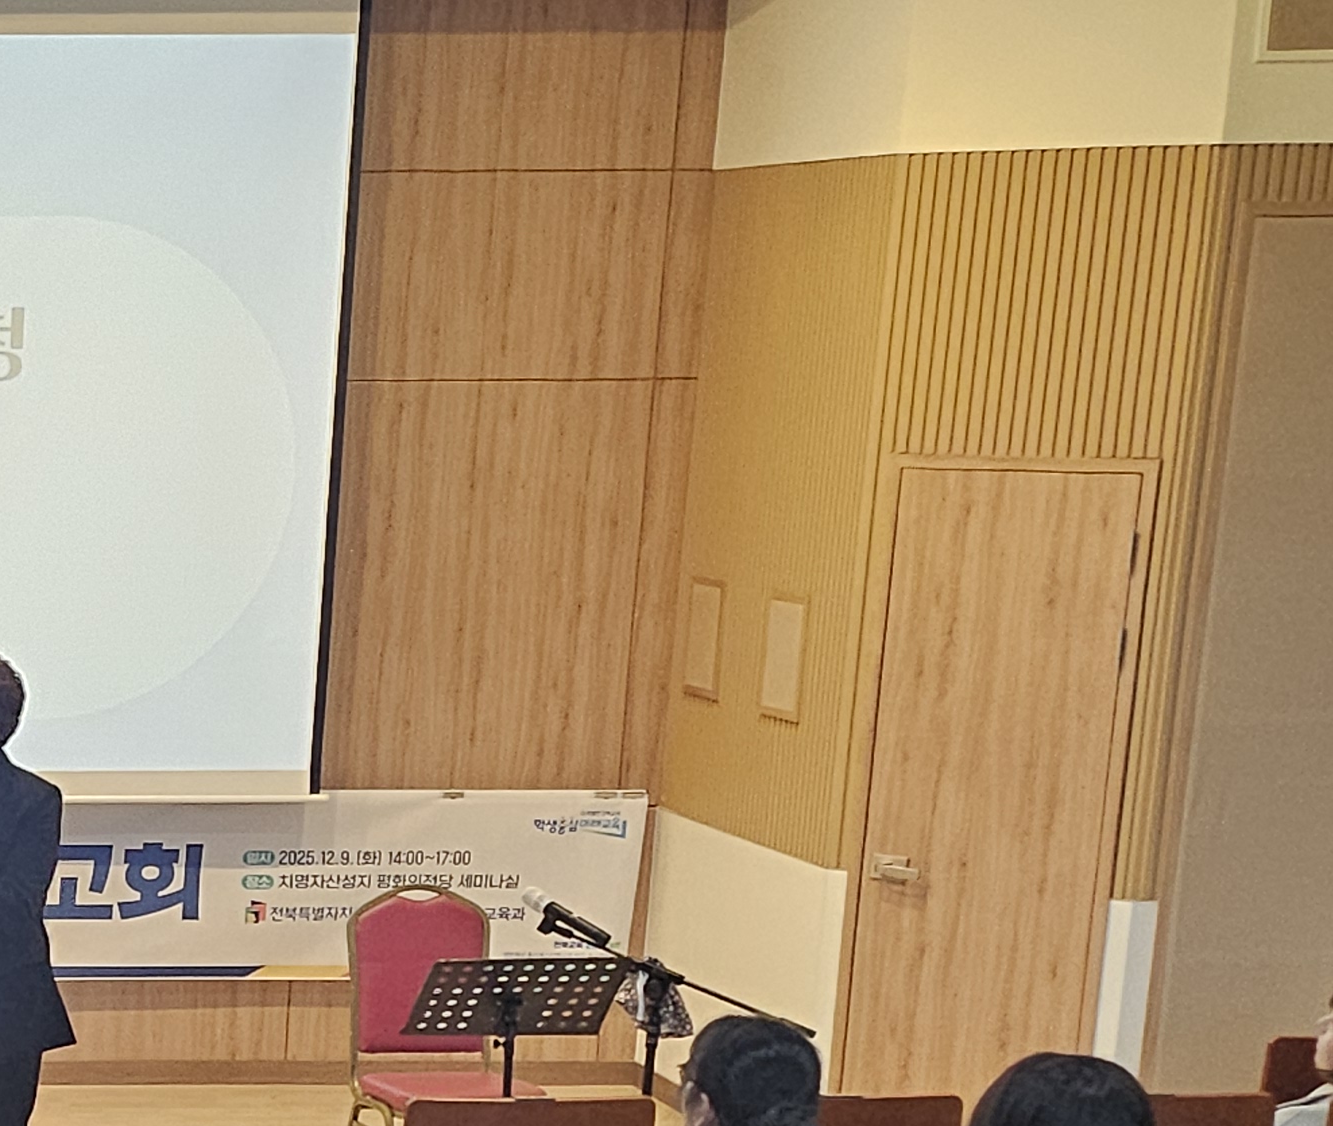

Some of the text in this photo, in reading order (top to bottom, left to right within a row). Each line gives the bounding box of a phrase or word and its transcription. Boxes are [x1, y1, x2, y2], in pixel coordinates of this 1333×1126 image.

[388, 850, 471, 865] 14:00~17:00
[43, 843, 204, 920] 고회
[278, 874, 371, 889] 치명자산성지
[457, 874, 520, 888] 세미나실
[270, 906, 353, 921] 전북특별자치
